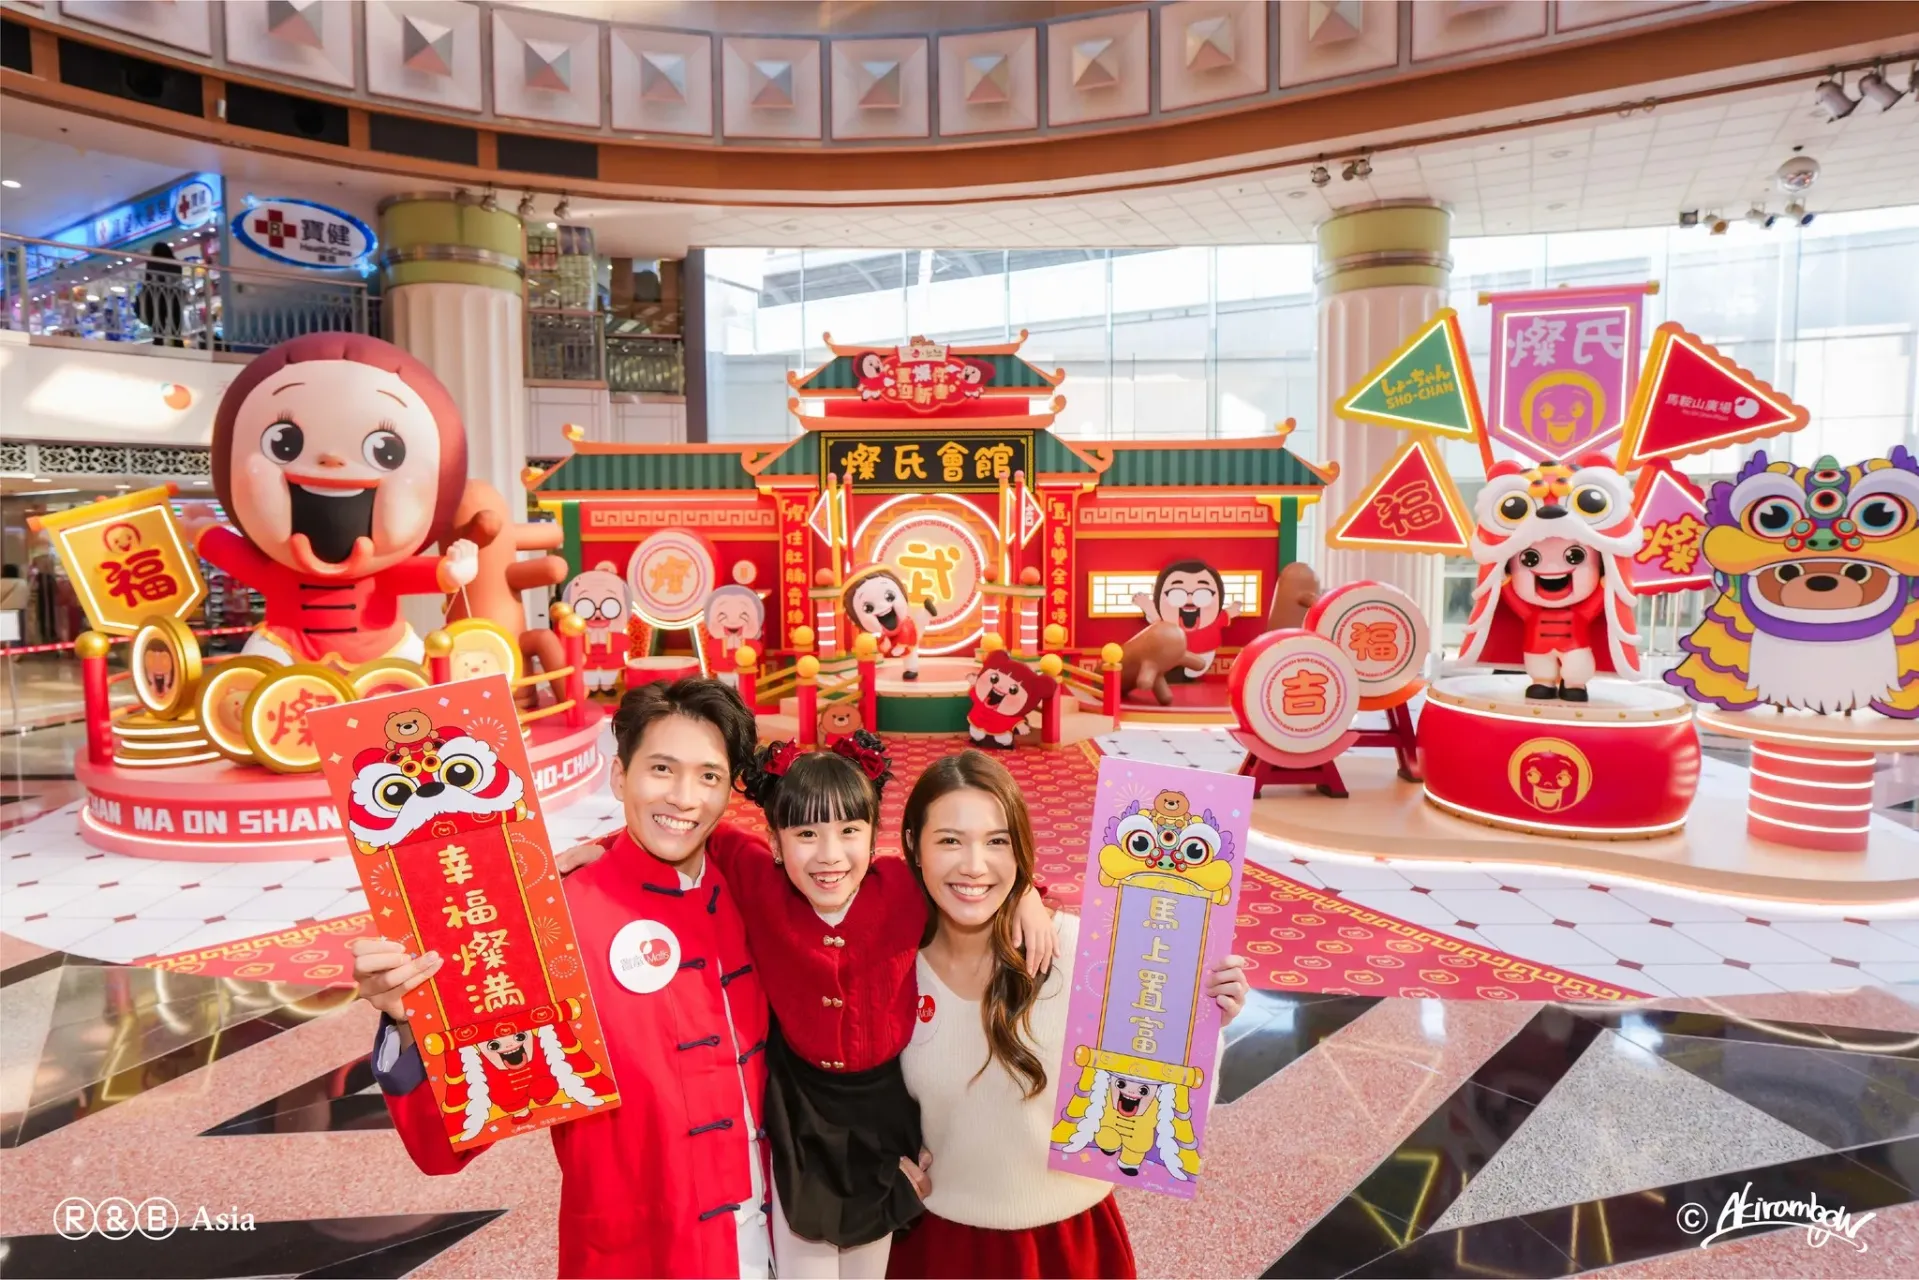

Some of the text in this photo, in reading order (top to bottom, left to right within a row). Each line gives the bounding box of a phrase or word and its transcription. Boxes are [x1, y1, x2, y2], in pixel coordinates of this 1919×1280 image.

[1507, 316, 1624, 368] 燦氏
[1386, 381, 1454, 410] SHO-CHAN
[840, 441, 1014, 482] 燦氏會館
[1374, 480, 1443, 537] 福
[1635, 513, 1706, 574] 燦
[101, 549, 177, 608] 福
[1349, 622, 1399, 662] 福
[1282, 669, 1329, 715] 吉
[533, 743, 597, 793] HO-CHAN
[133, 806, 174, 833] MA
[183, 810, 228, 834] ON
[239, 805, 343, 834] SHAN
[438, 844, 526, 1014] 幸福燦滿
[1129, 896, 1180, 1054] 馬上置富
